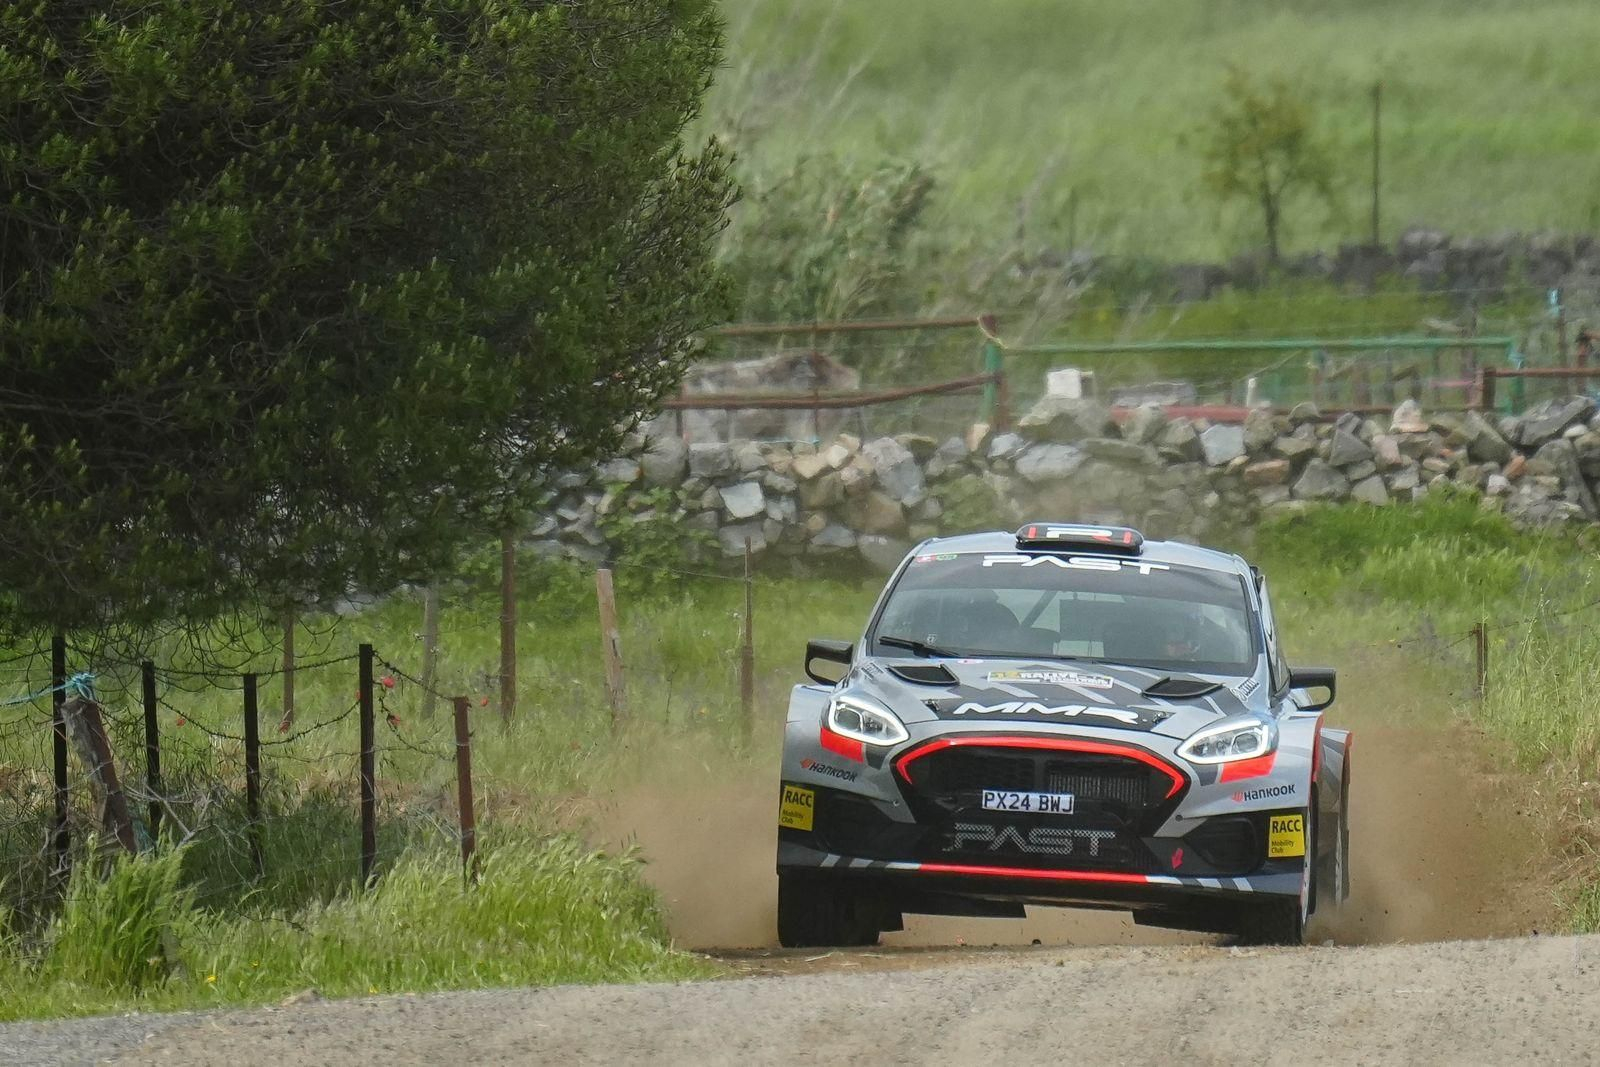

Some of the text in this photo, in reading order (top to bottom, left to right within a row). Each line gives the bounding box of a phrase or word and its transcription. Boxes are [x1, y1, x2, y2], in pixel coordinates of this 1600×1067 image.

[982, 554, 1170, 575] PAST
[953, 702, 1139, 725] MMR
[785, 790, 813, 809] RACC
[983, 791, 1073, 813] PX24 BWJ
[1271, 819, 1302, 834] RACC
[955, 822, 1116, 857] PAST
[1271, 840, 1295, 848] Mobility
